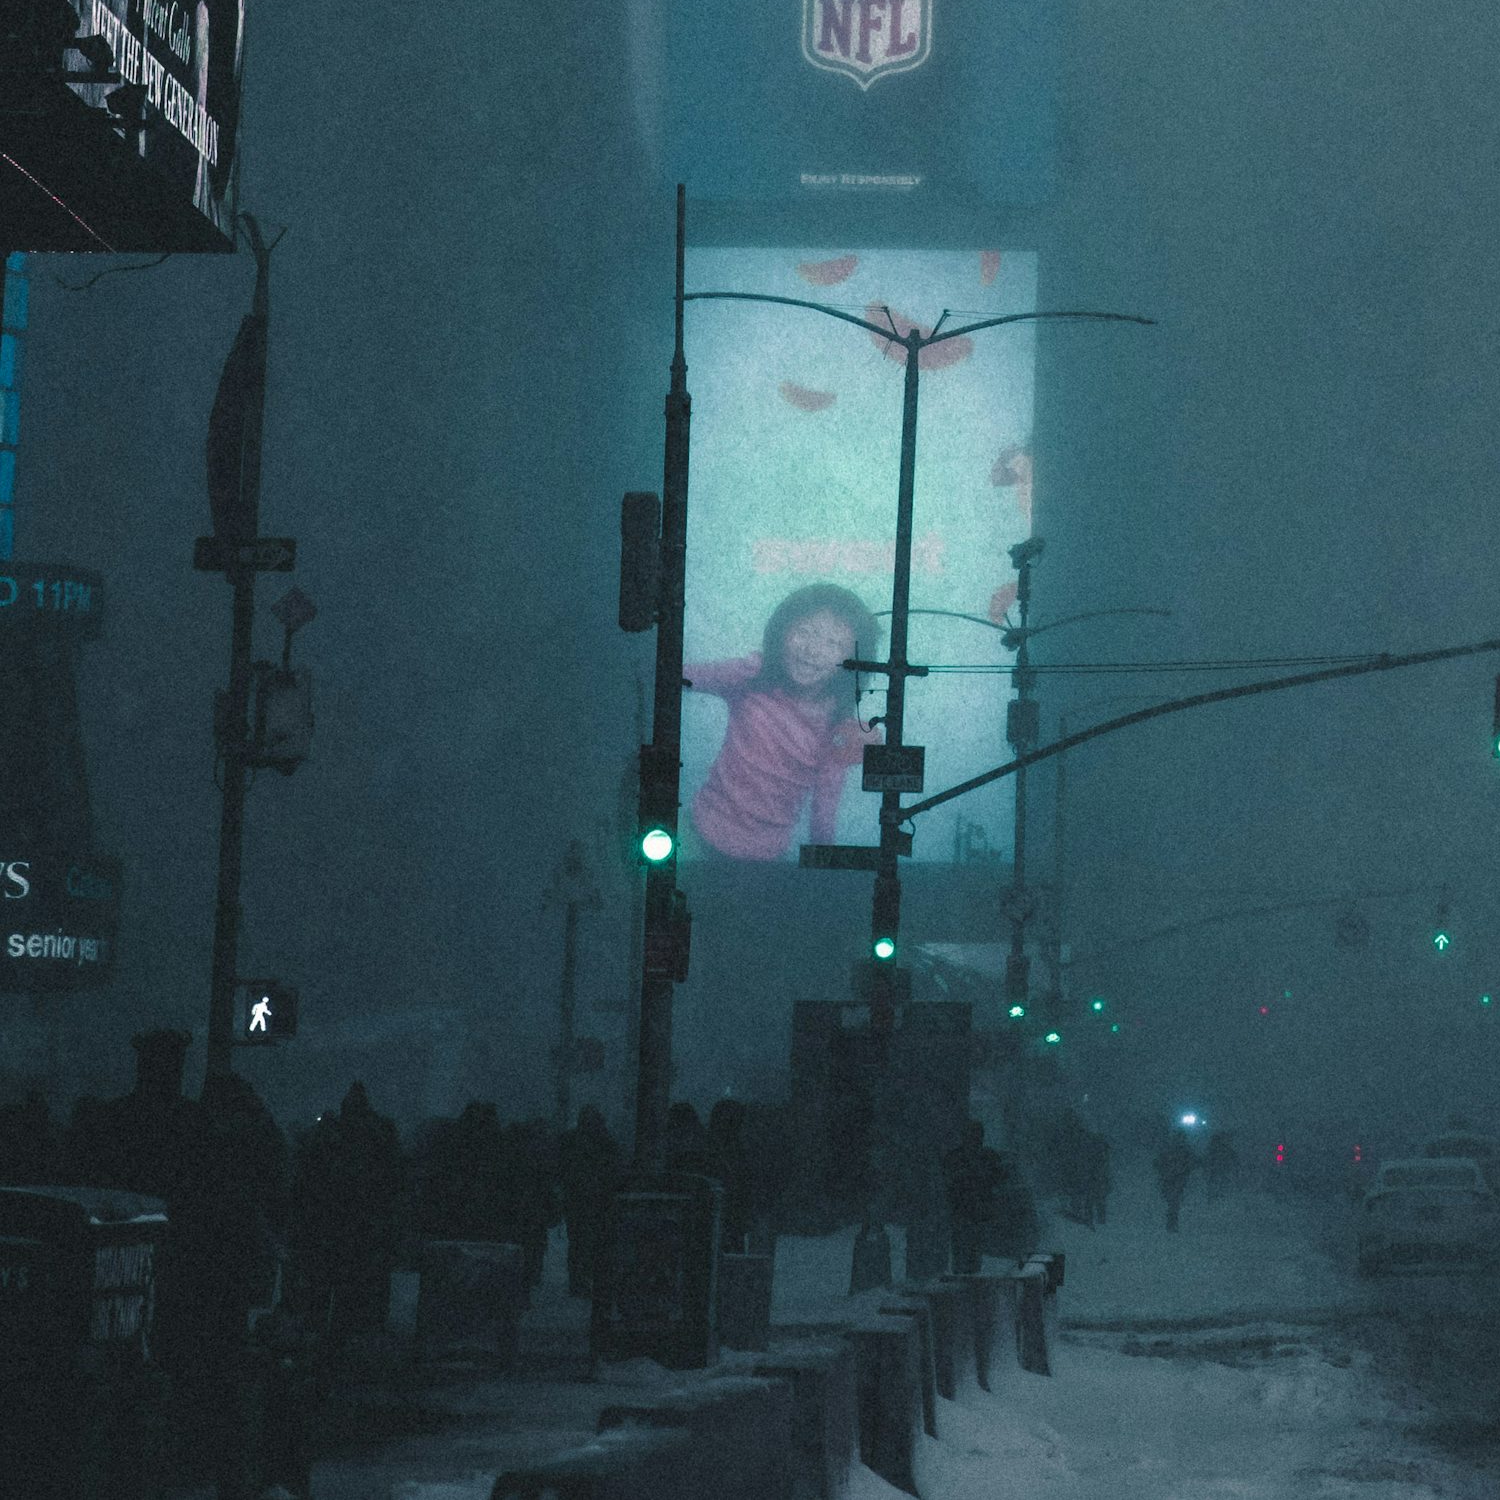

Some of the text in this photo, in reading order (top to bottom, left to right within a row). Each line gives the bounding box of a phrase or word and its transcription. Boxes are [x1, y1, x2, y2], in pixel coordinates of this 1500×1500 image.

[120, 22, 142, 85] THE
[141, 46, 165, 111] NEW
[164, 73, 220, 167] GENERATION
[7, 927, 76, 958] senior
